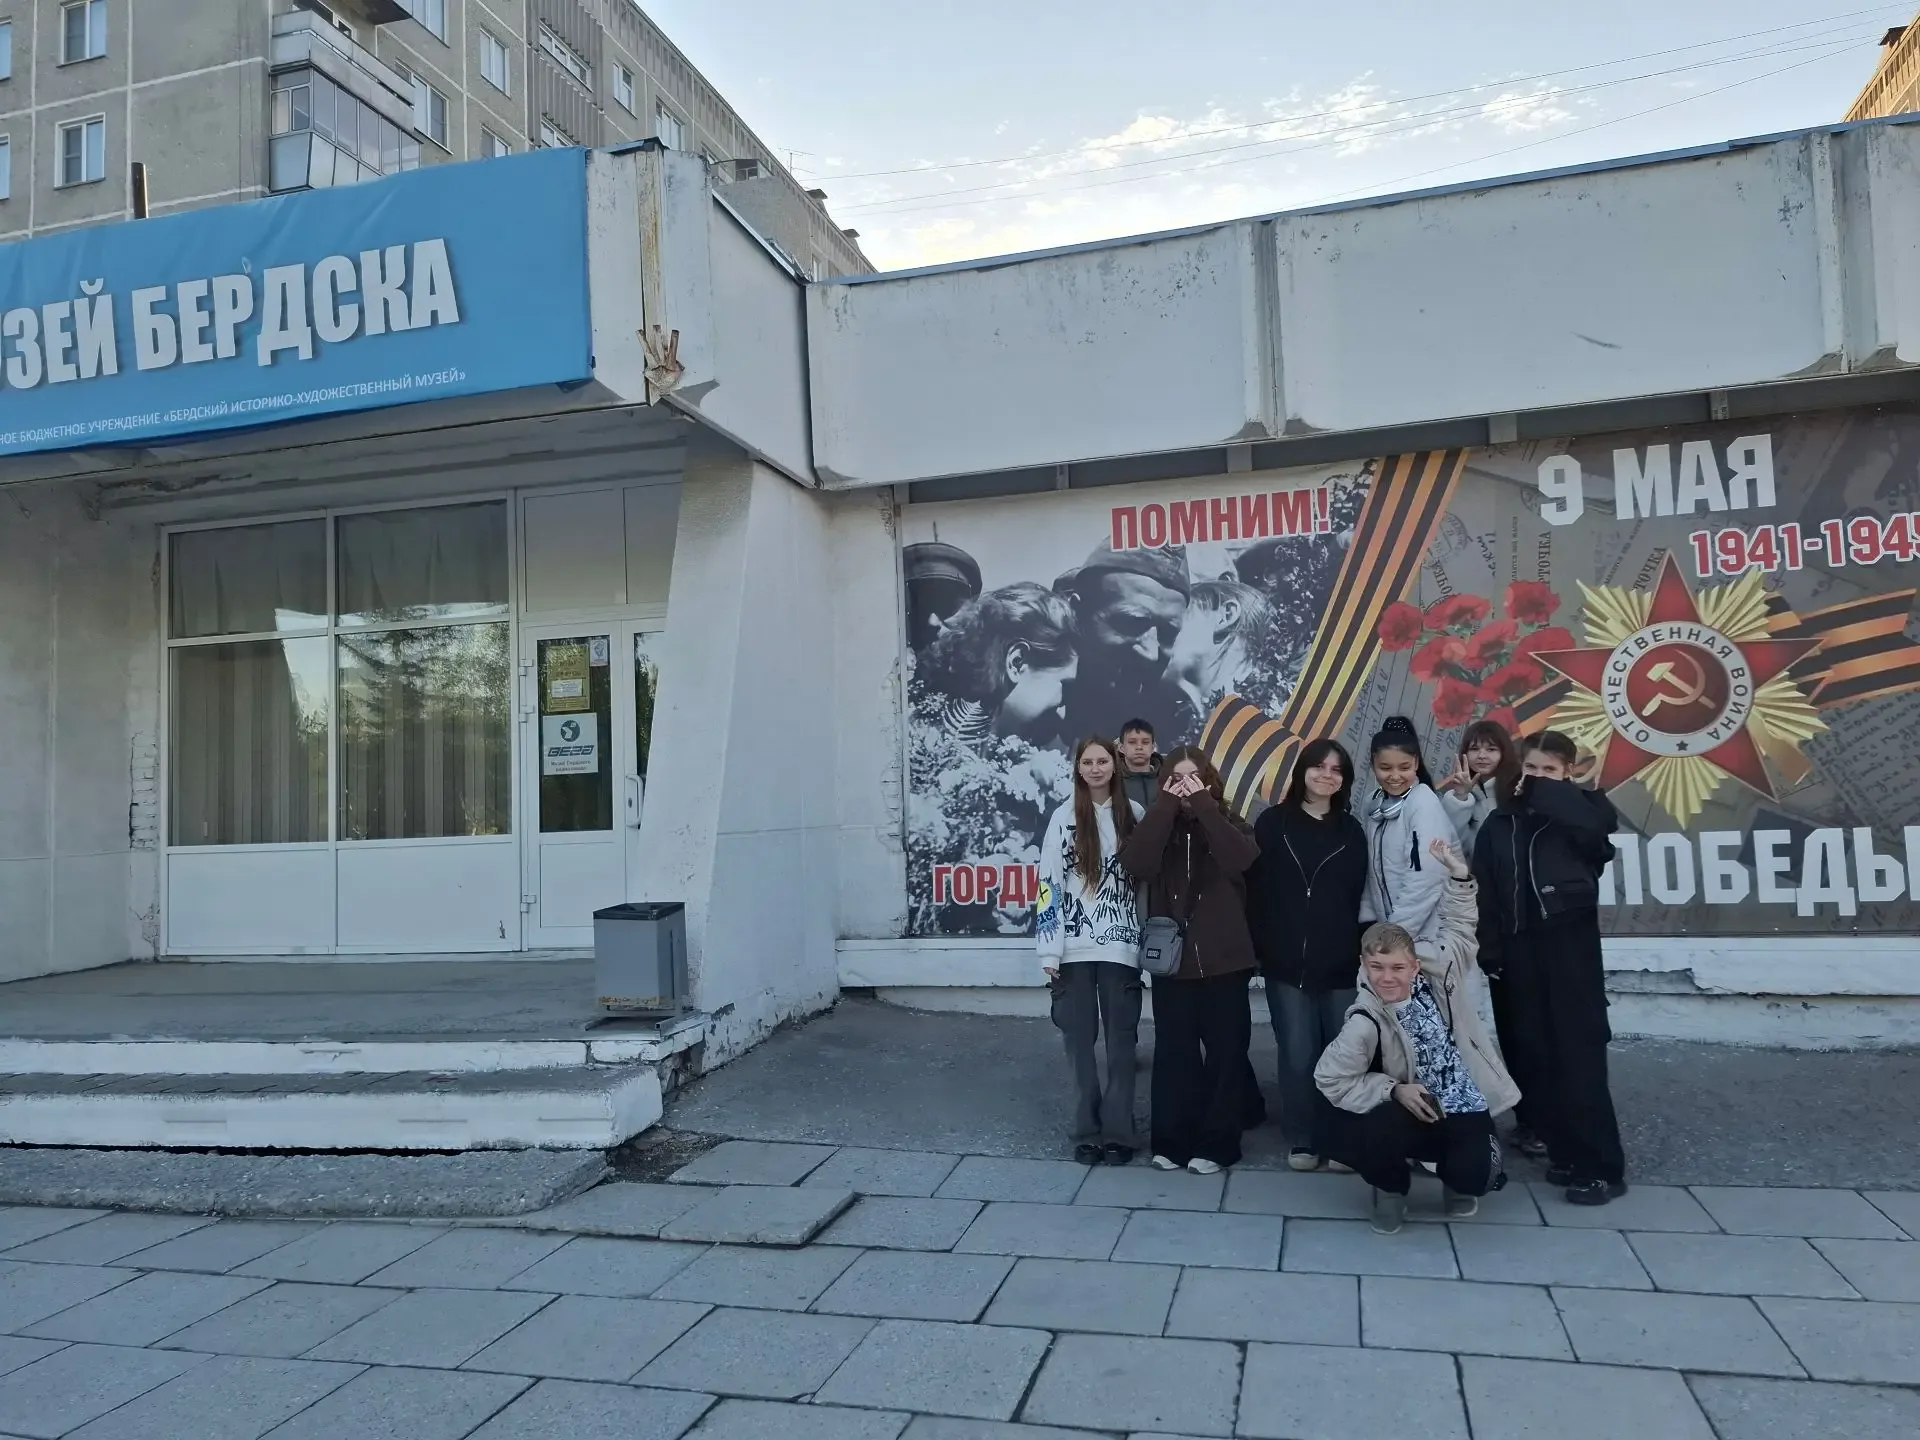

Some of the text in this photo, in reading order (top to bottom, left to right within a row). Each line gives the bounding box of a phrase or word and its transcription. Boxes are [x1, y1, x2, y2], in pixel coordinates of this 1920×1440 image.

[0, 238, 460, 389] ЗЕЙ БЕРДСКА
[20, 422, 86, 443] БЮДЖЕТНОЕ
[88, 412, 161, 434] УЧРЕЖДЕНИЕ
[163, 400, 229, 422] «БЕРДСКИЙ
[231, 373, 412, 413] ИСТОРИКО-ХУДОЖЕСТВЕННЫЙ
[415, 367, 467, 388] МУЗЕЙ»
[1110, 486, 1332, 552] ПОМНИМ!
[1537, 433, 1776, 526] 9 МАЯ
[1607, 626, 1749, 743] ОТЕЧЕСТВЕННАЯ ВОЙНА
[1598, 825, 1920, 917] ПОБЕДЫ
